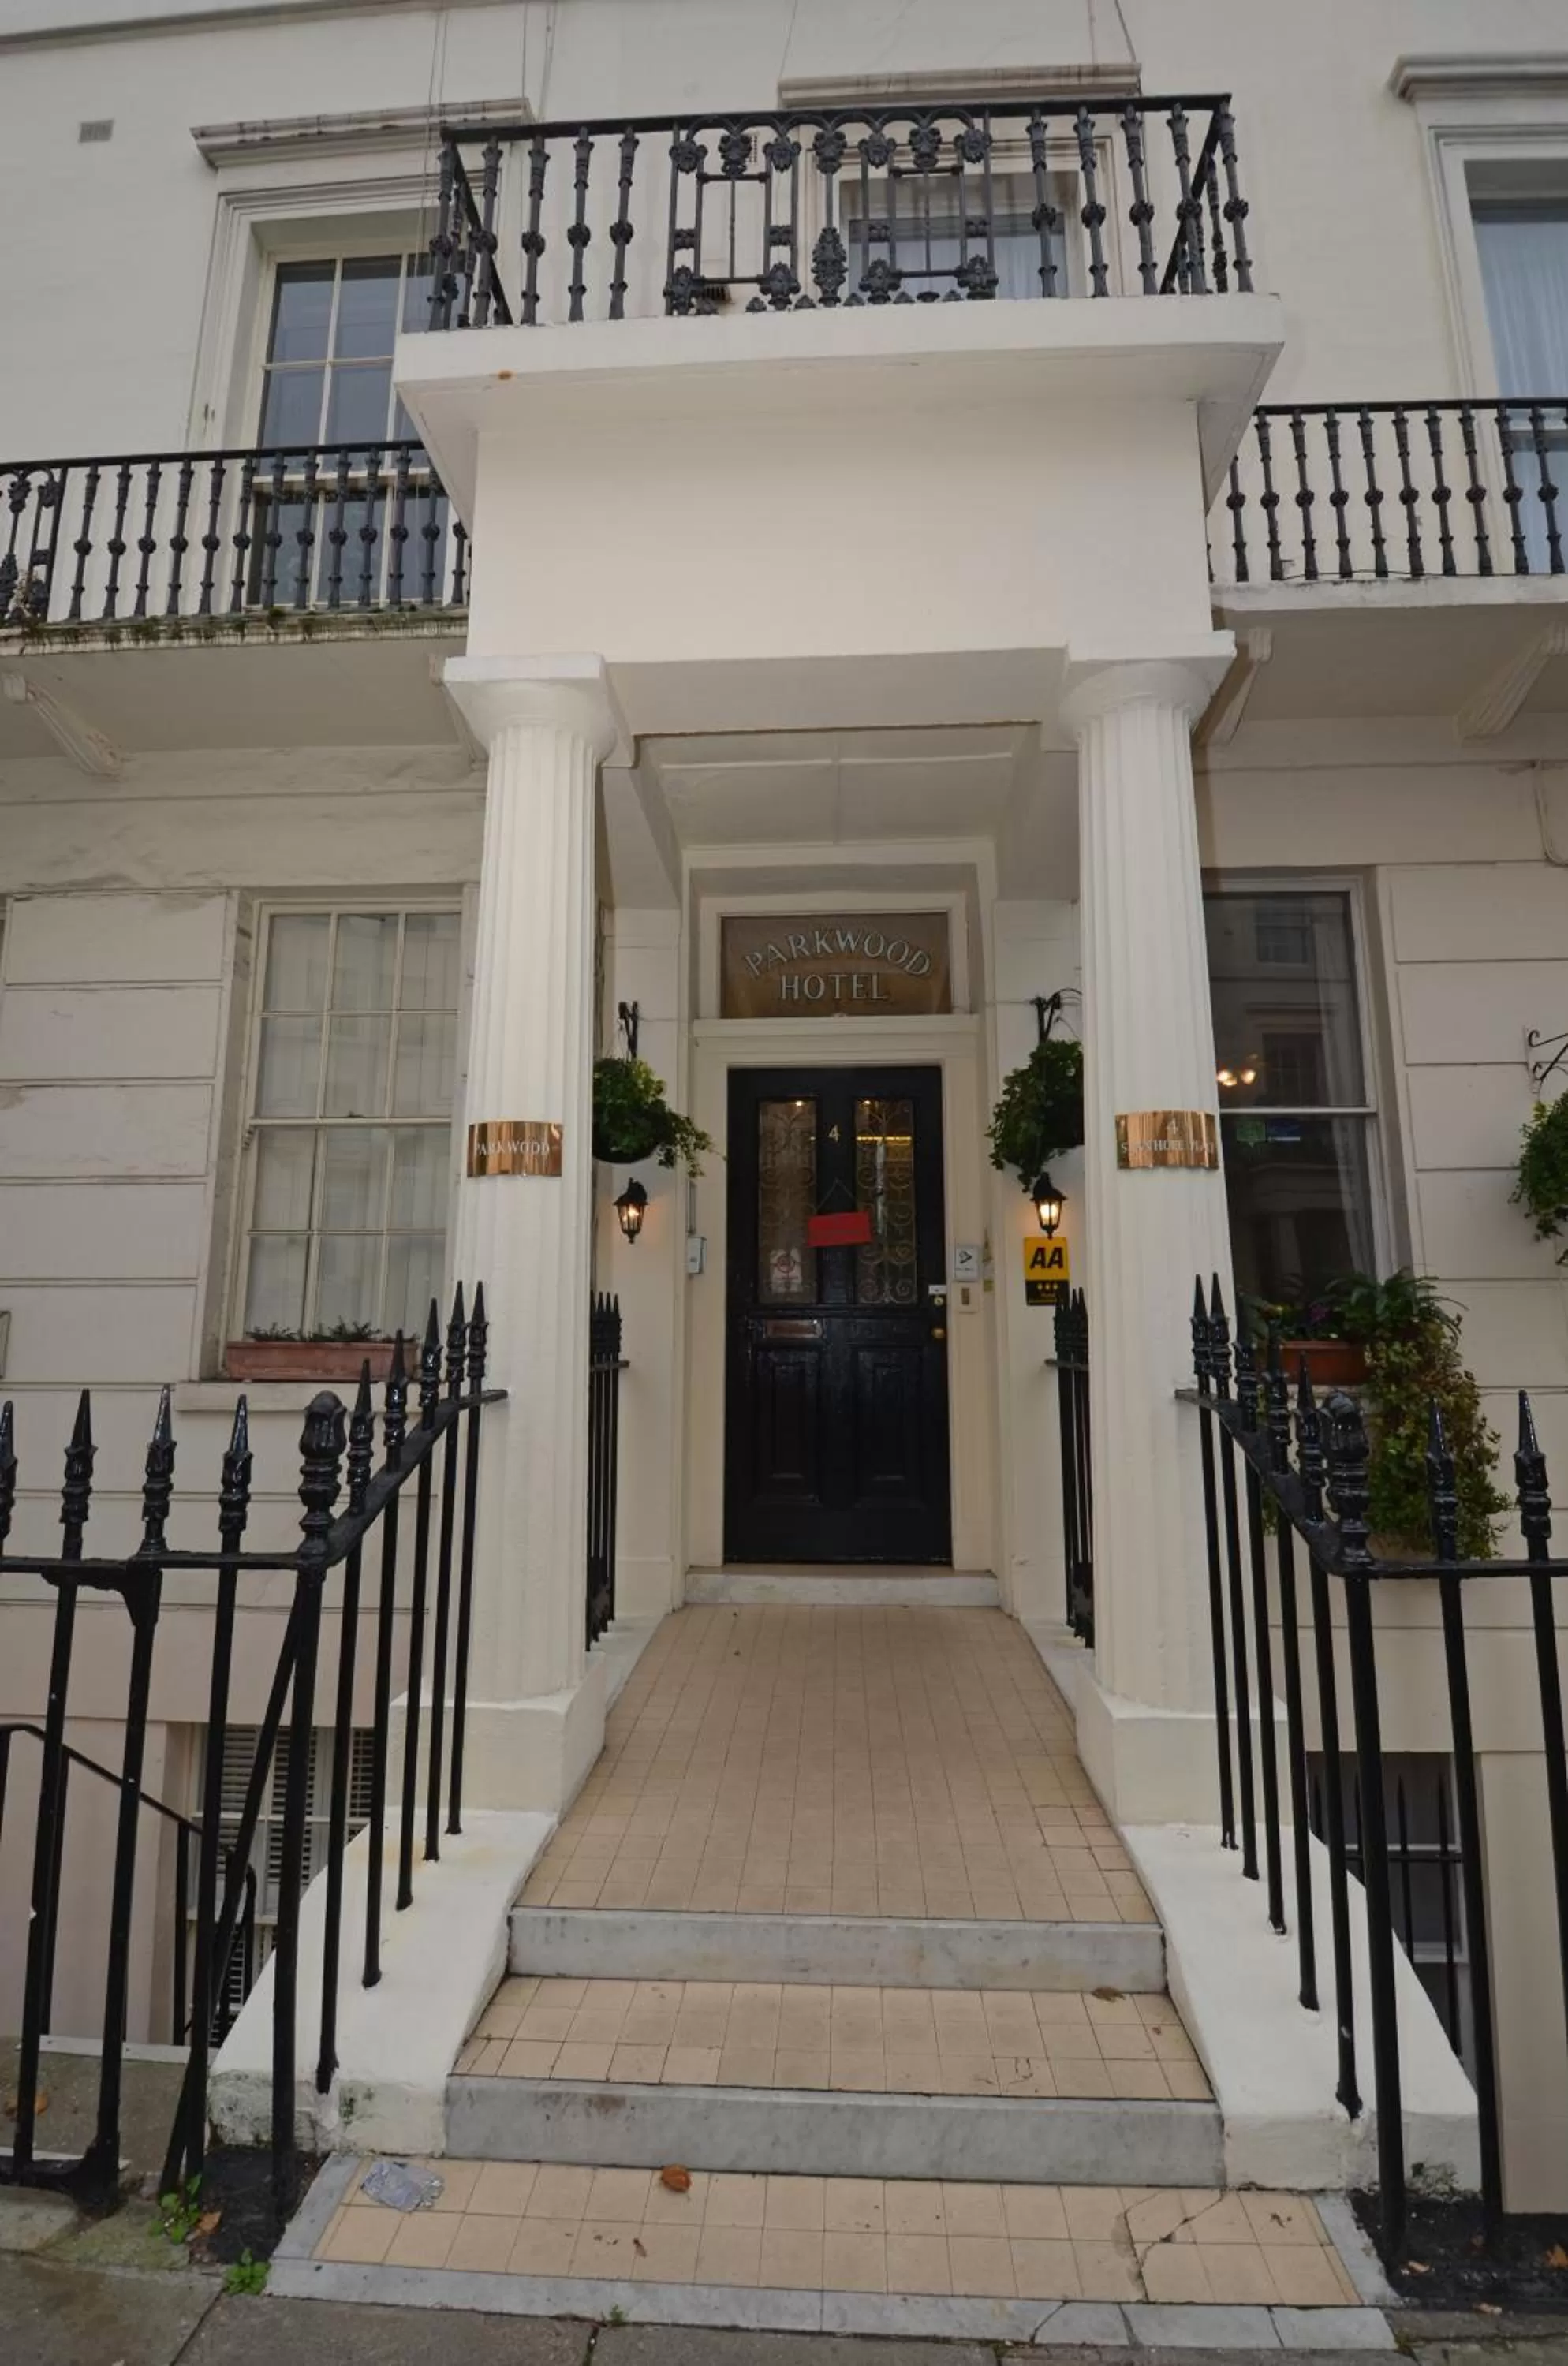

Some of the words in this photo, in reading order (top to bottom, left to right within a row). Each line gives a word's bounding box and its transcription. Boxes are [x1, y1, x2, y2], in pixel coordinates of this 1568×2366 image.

[745, 929, 931, 976] PARKWOOD
[780, 974, 889, 1001] HOTEL
[828, 1125, 839, 1142] 4
[1029, 1247, 1063, 1269] AA
